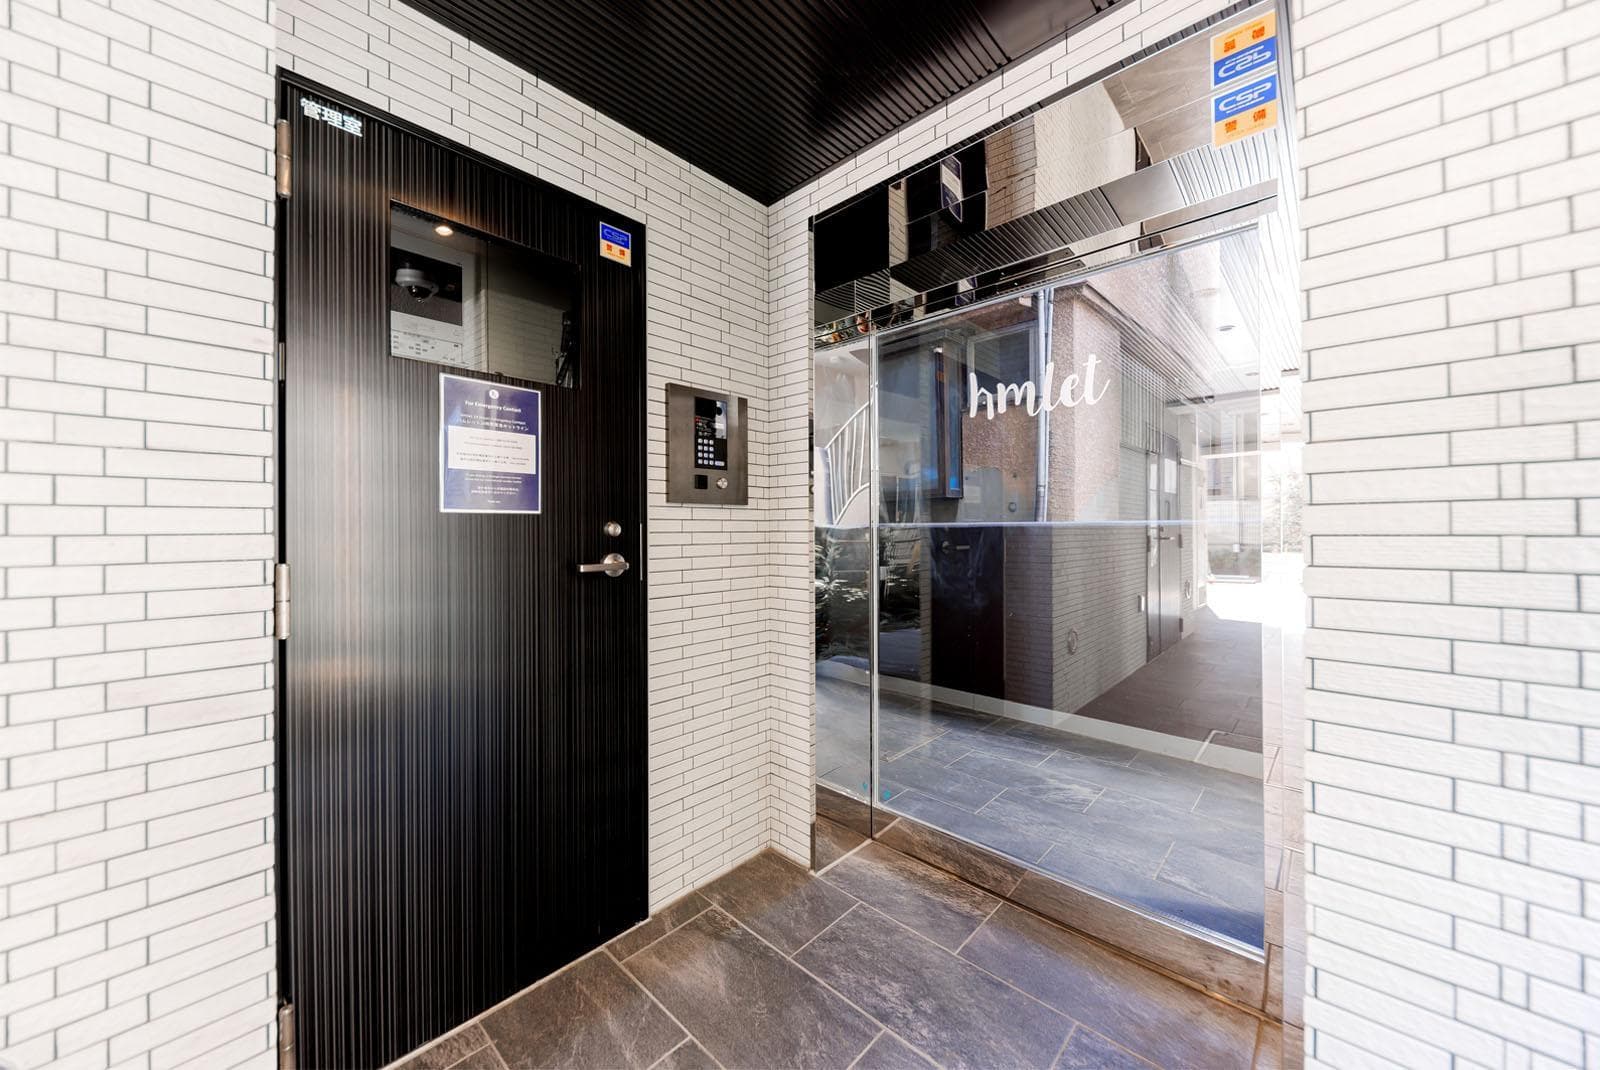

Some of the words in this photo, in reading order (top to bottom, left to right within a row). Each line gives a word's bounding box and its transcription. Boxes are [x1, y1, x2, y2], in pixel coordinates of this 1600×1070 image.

[1218, 82, 1272, 112] CSP
[300, 97, 363, 137] 管理室
[603, 228, 628, 243] CSP
[969, 353, 1111, 420] hmlet
